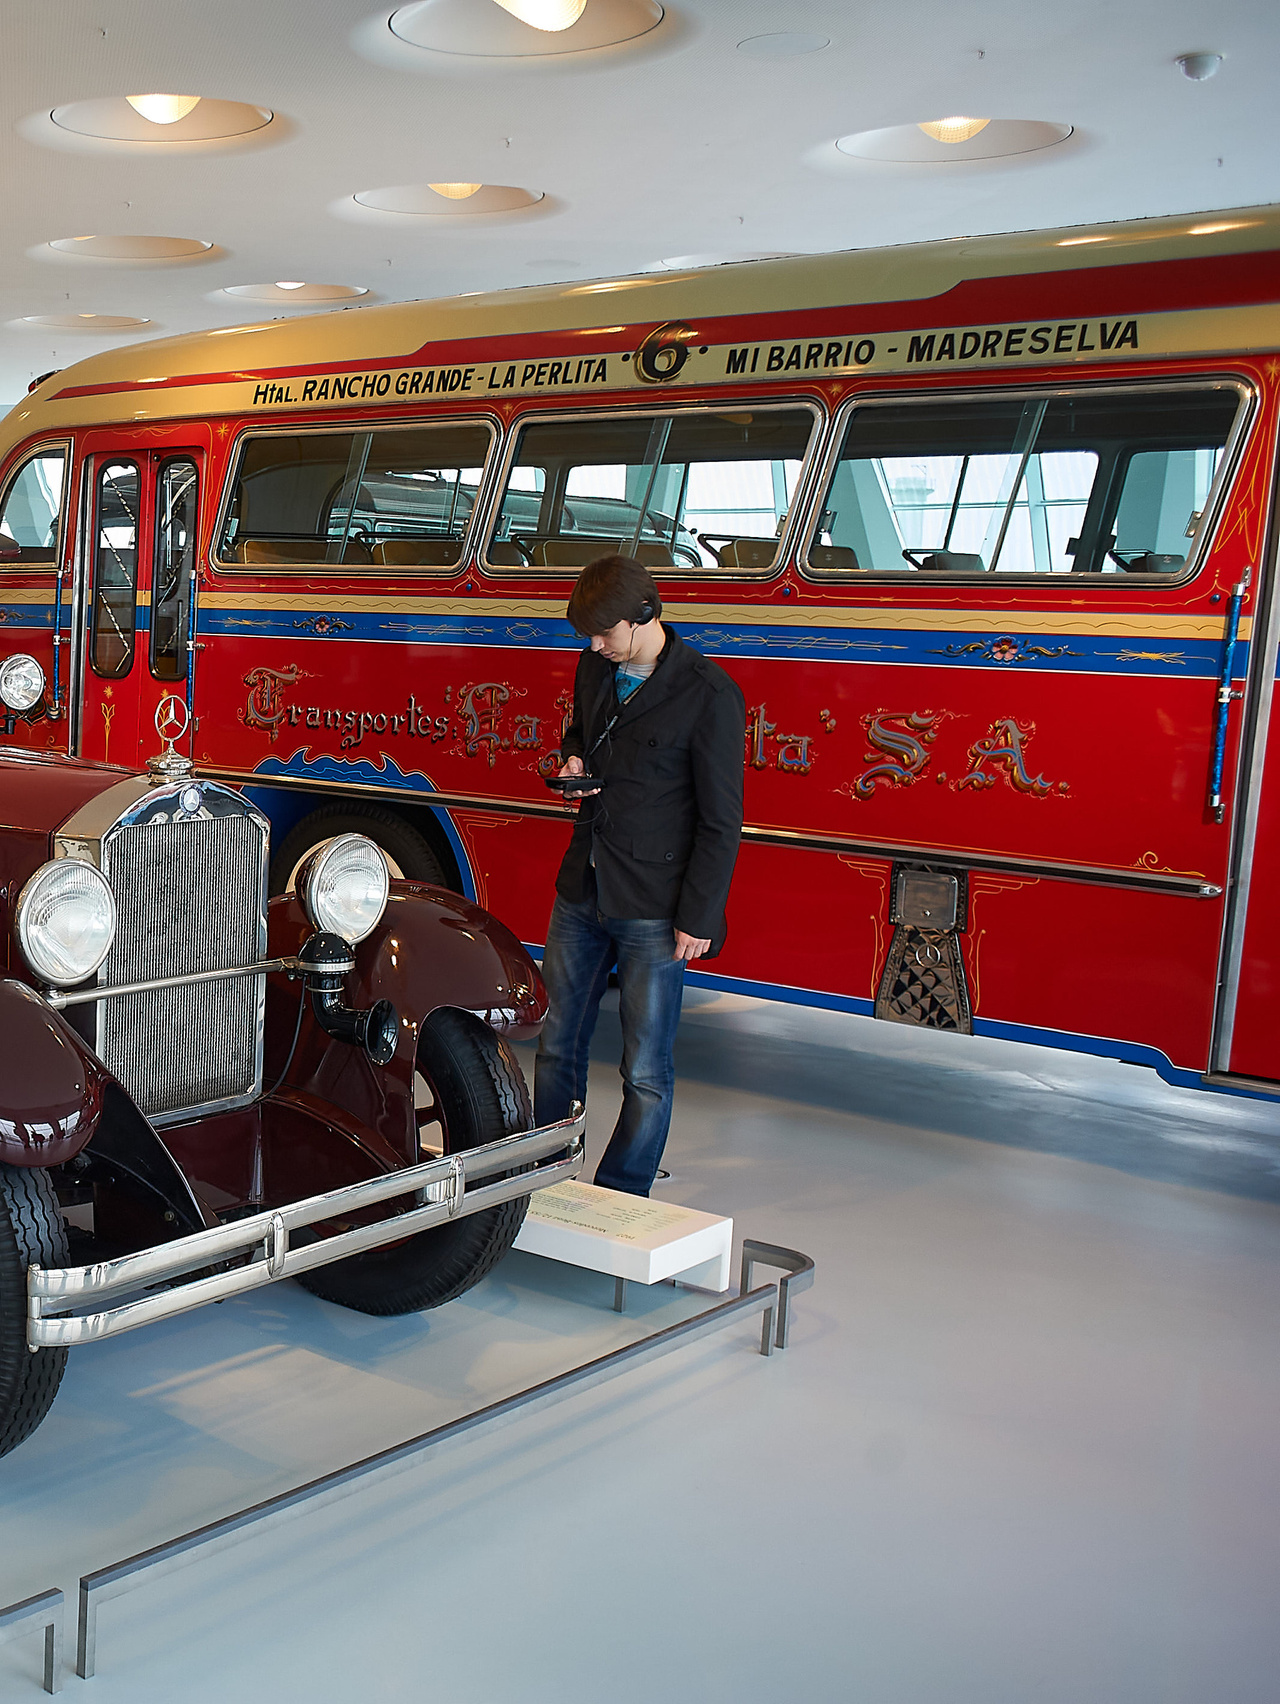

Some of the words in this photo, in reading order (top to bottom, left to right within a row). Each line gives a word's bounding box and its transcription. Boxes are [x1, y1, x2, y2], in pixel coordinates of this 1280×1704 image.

[302, 373, 391, 402] RANCHO
[395, 367, 473, 395] GRANDE
[487, 365, 516, 389] LA
[519, 358, 608, 386] PERLITA
[632, 319, 694, 384] 6
[725, 347, 760, 375] MI
[766, 338, 876, 372] BARRIO
[906, 319, 1140, 363] MADRESELVA
